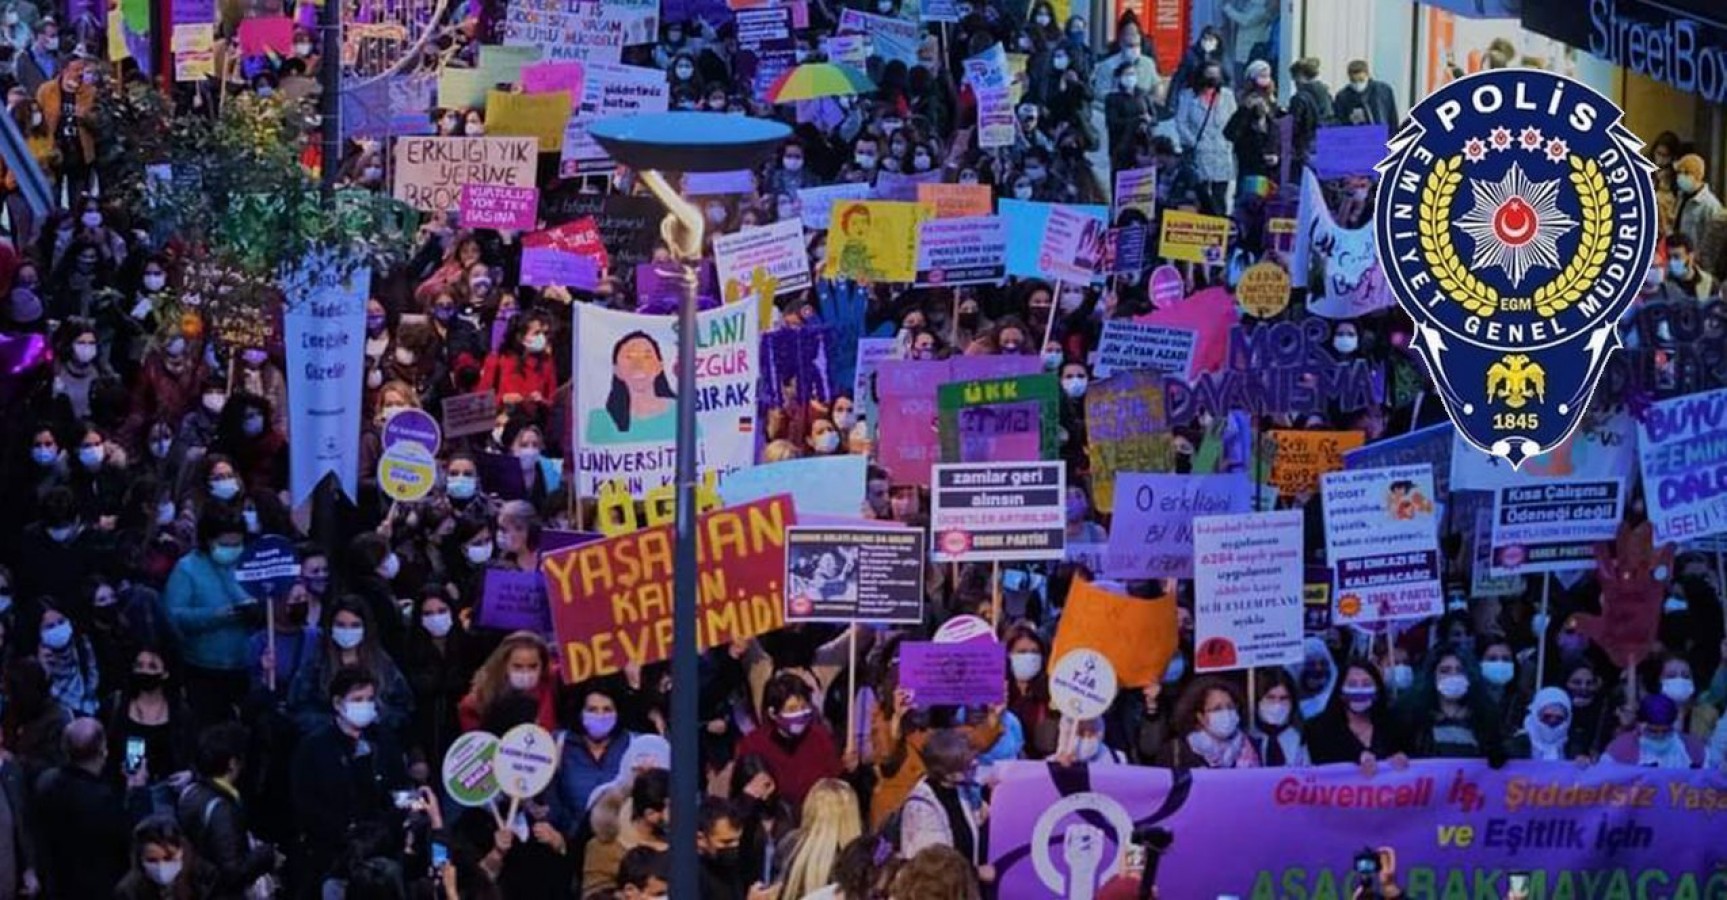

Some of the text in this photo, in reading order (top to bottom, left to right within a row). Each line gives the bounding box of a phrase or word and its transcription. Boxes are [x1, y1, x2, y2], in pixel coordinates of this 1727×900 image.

[952, 469, 1007, 485] zamlar
[1437, 824, 1474, 846] ve
[1594, 812, 1654, 856] İçin
